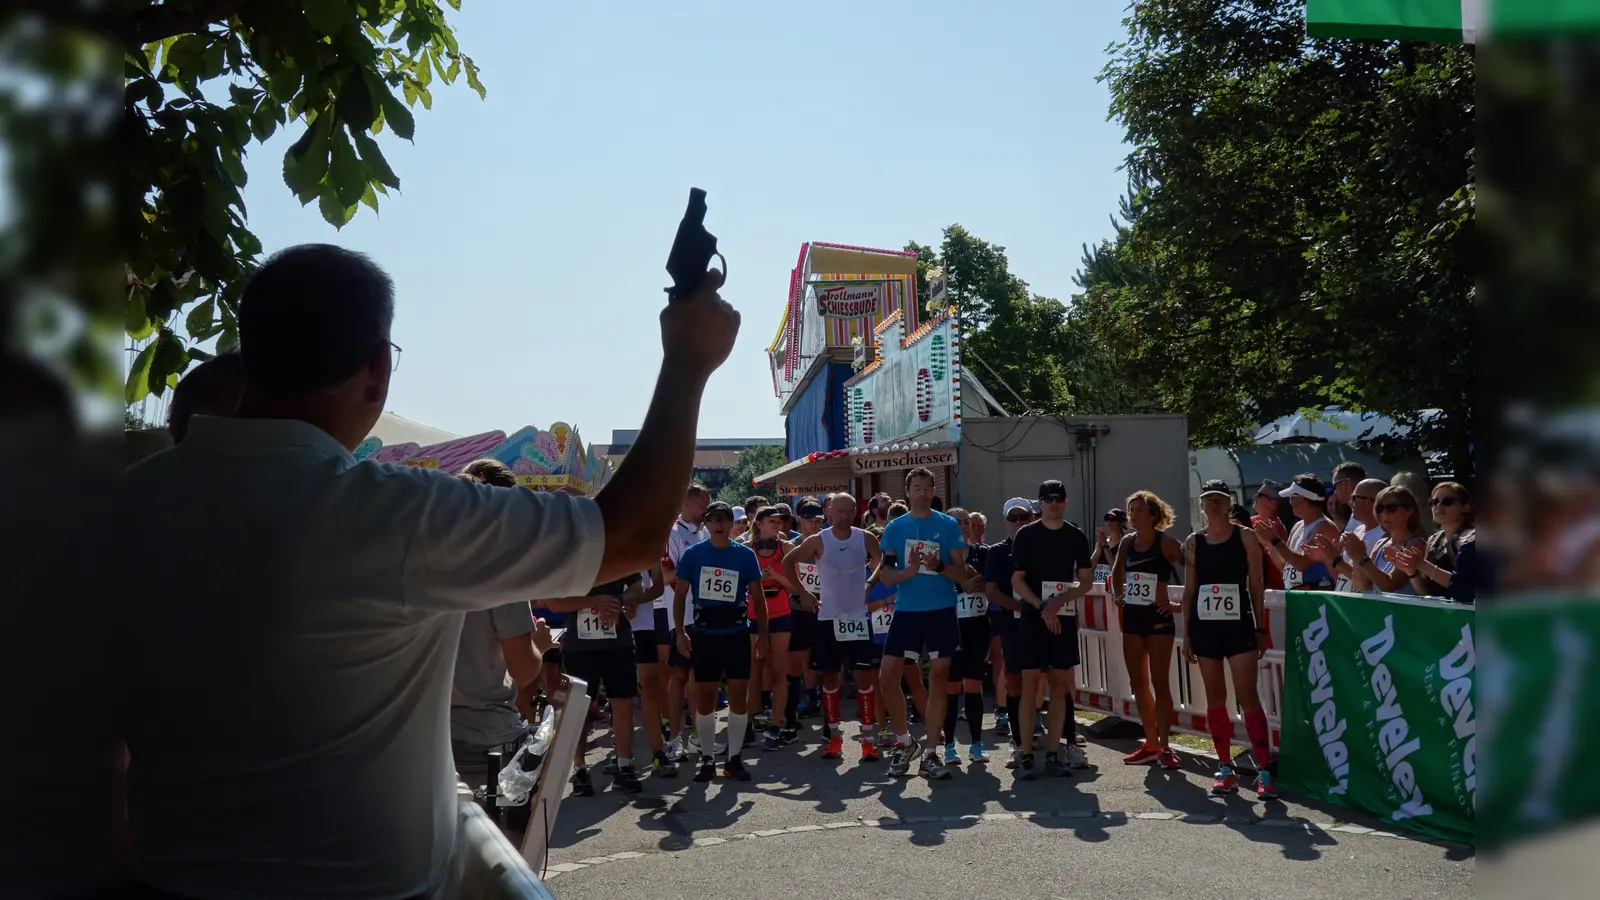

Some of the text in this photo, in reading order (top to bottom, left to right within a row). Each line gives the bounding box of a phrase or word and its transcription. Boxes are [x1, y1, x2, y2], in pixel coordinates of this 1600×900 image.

[819, 295, 877, 316] SCHIESSBUDE
[855, 452, 954, 471] Sternschiessen
[780, 483, 848, 494] Sternschiessen
[705, 578, 732, 593] 156
[800, 572, 821, 586] 760
[1127, 583, 1151, 597] 233
[959, 596, 984, 610] 173
[1203, 596, 1234, 611] 176
[838, 621, 864, 634] 804
[1302, 604, 1350, 795] Develey
[1360, 614, 1434, 821] Develey
[1438, 716, 1447, 729] &
